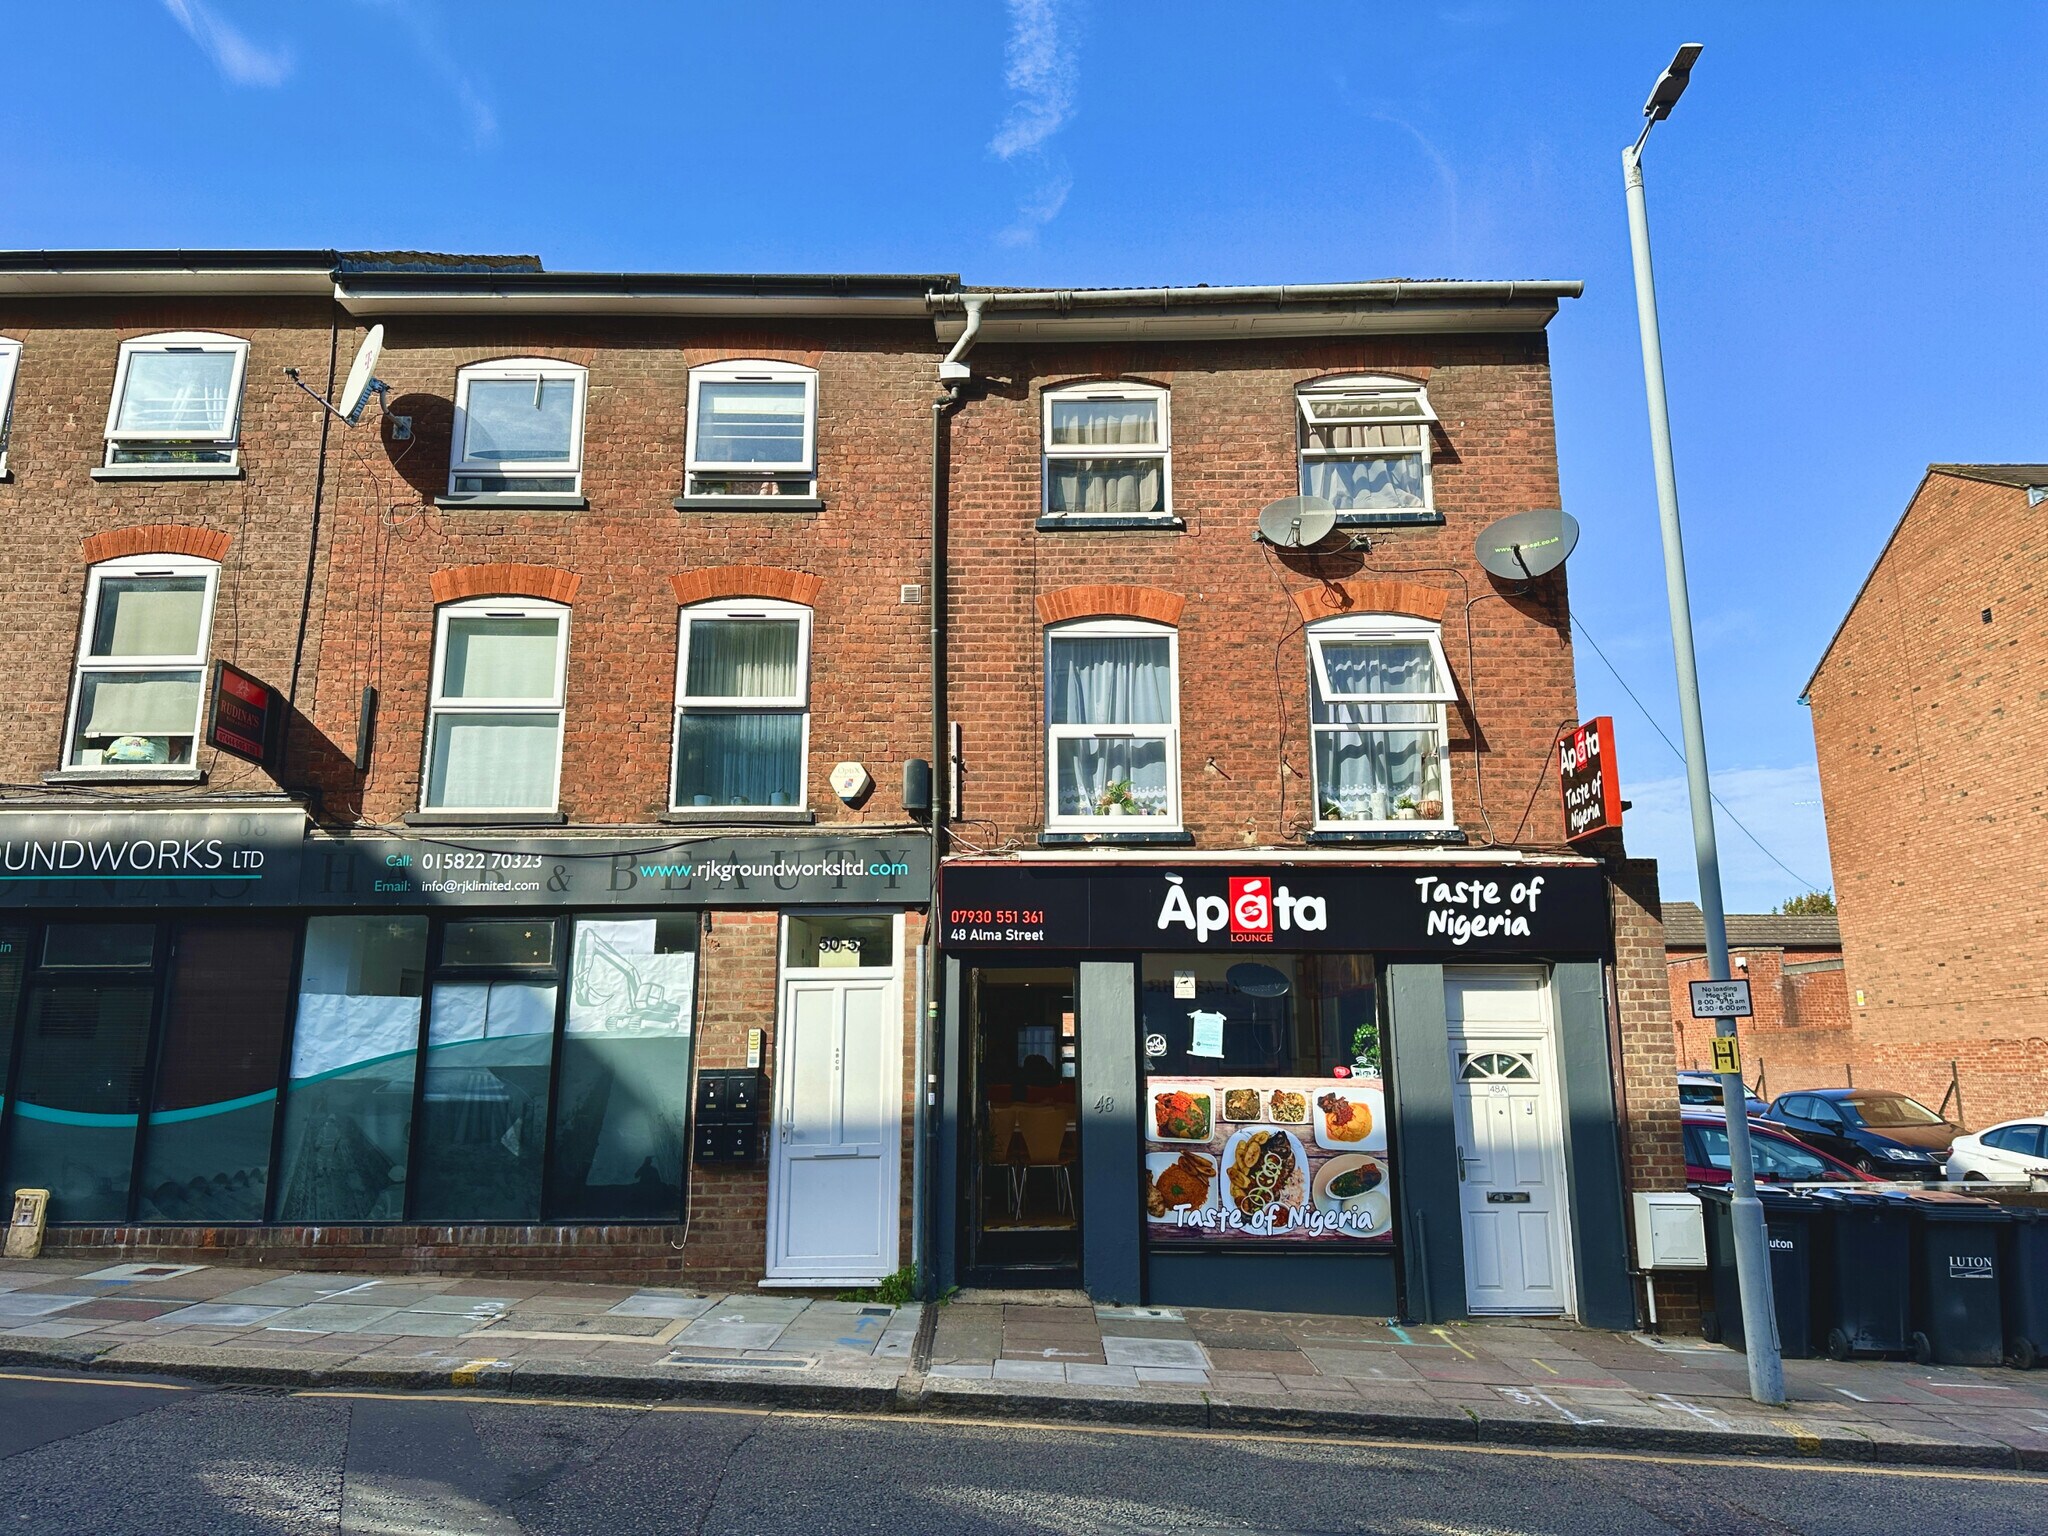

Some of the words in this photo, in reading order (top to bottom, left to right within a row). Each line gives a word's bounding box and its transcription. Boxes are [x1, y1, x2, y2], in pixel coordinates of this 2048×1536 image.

[220, 699, 260, 728] RUDINA'S
[1566, 782, 1590, 809] Taste
[1591, 770, 1601, 799] of
[1571, 800, 1600, 833] Nigeria
[0, 839, 222, 870] UNDWORKS
[233, 851, 264, 868] LTD
[386, 855, 412, 867] Call:
[422, 853, 486, 870] 015822
[491, 853, 542, 869] 70323
[640, 859, 908, 882] www.rjkgroundworksltd.com
[374, 880, 411, 892] Email:
[421, 880, 540, 894] info@rjklimited.com
[1415, 876, 1501, 909] Taste
[1510, 876, 1545, 912] of
[951, 910, 992, 924] 07930
[996, 910, 1018, 924] 551
[1022, 910, 1044, 924] 361
[1157, 872, 1327, 943] Àpáta
[950, 929, 967, 941] 48
[969, 929, 1002, 941] Alma
[1005, 929, 1044, 941] Street
[1230, 933, 1274, 942] LOUNGE
[1427, 909, 1531, 946] Nigeria
[819, 936, 867, 951] 50-52
[1712, 1041, 1735, 1070] H
[1489, 1085, 1508, 1094] 48A
[1094, 1095, 1114, 1114] 48
[1173, 1203, 1243, 1232] Taste
[1251, 1204, 1280, 1236] of
[1287, 1205, 1374, 1237] Nigeria
[1769, 1239, 1793, 1249] uton
[1949, 1256, 1992, 1267] LUTON
